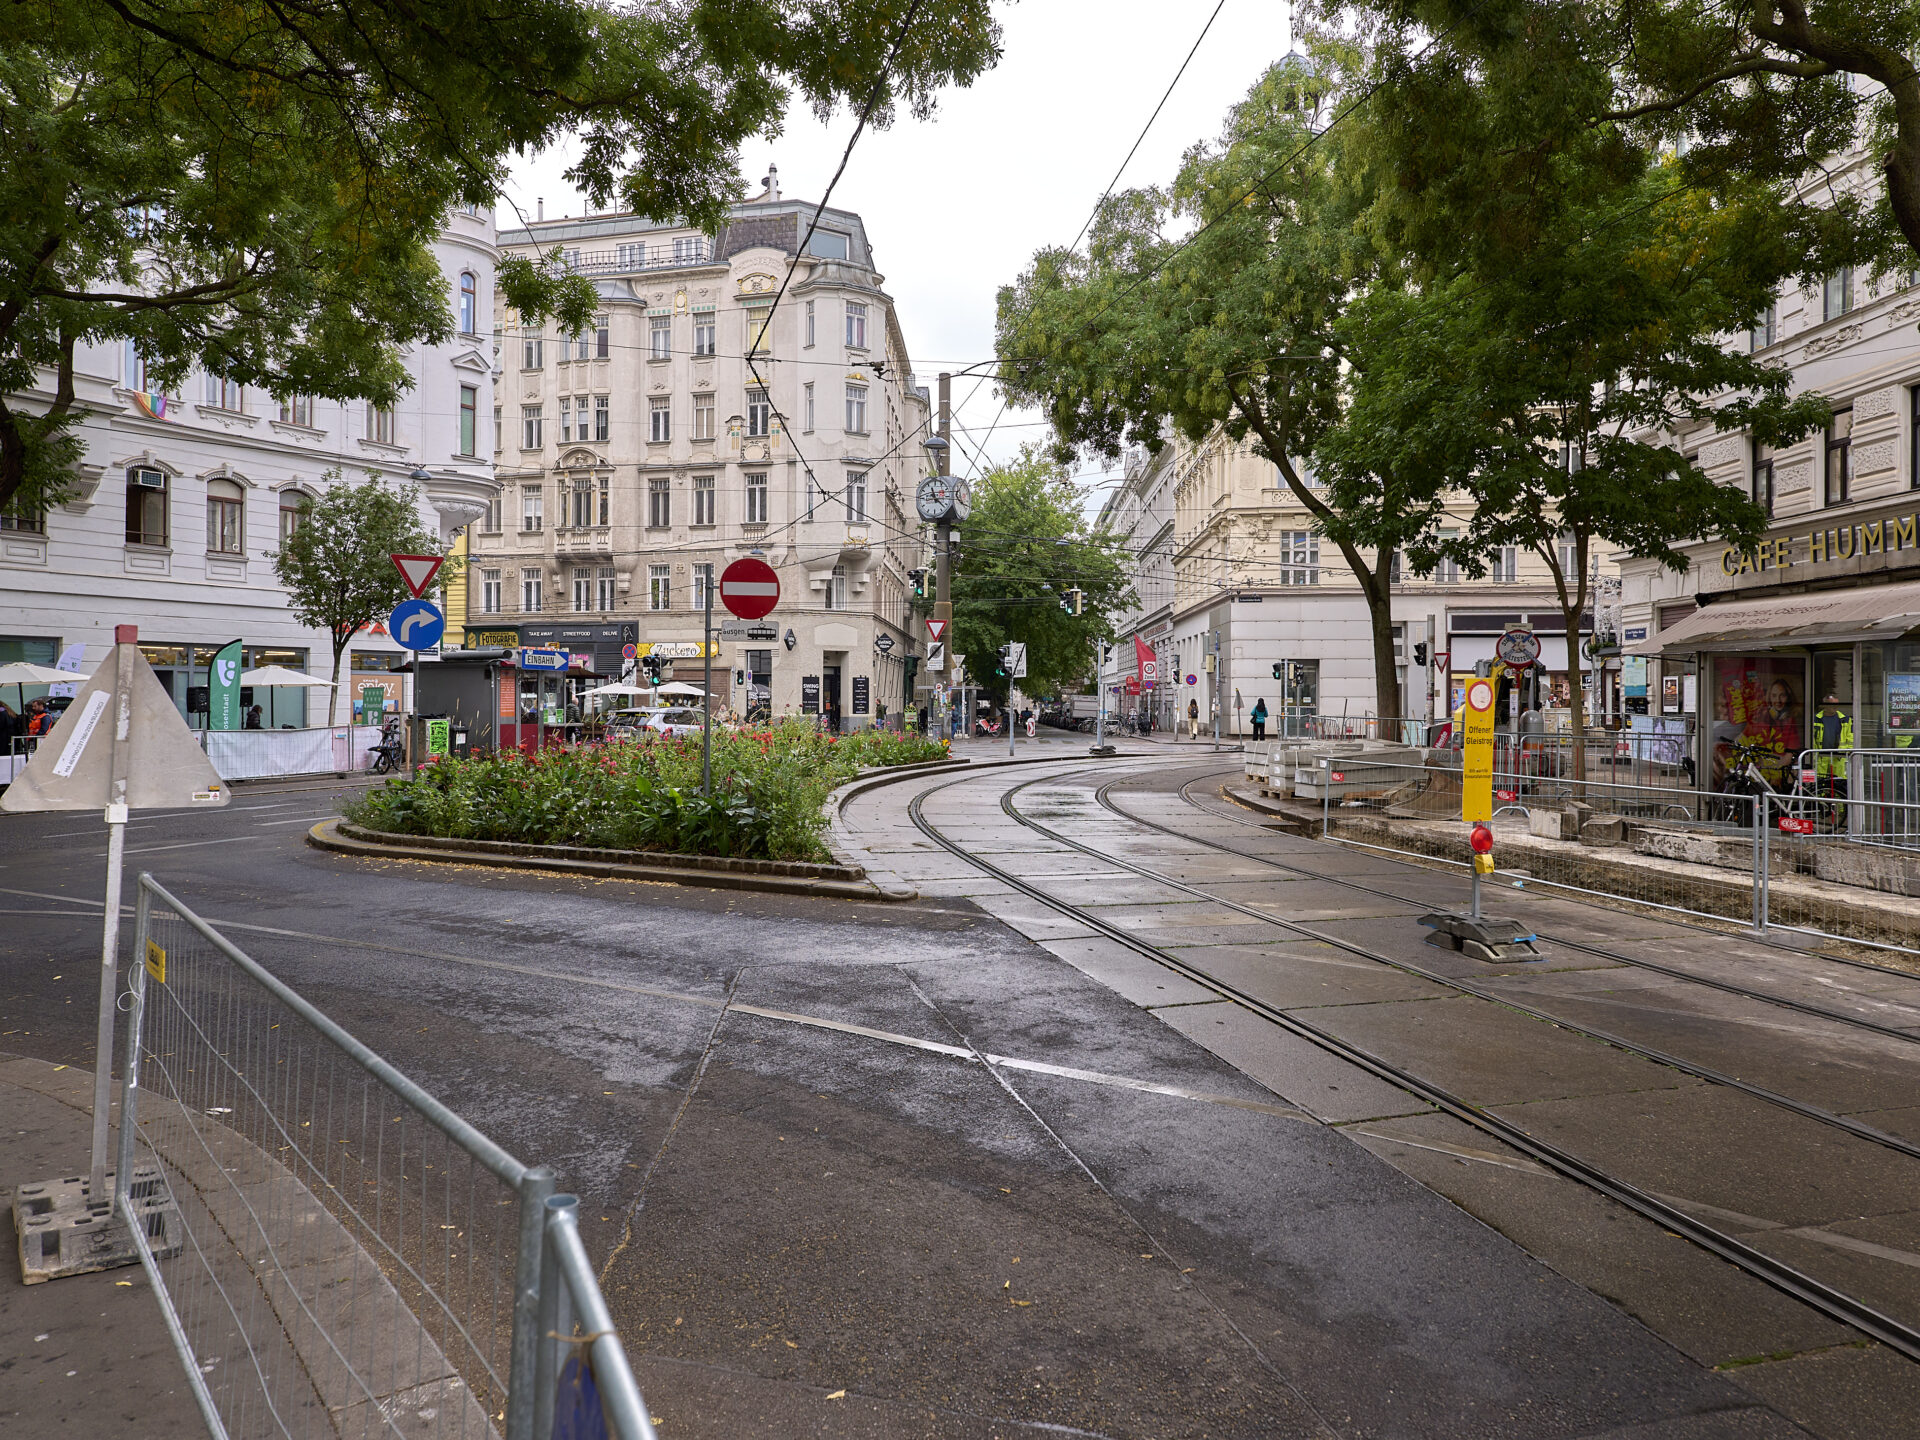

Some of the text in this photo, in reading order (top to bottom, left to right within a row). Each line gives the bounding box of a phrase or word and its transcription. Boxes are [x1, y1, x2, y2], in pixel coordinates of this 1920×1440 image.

[1720, 513, 1920, 577] CAFE HUMM
[482, 633, 517, 646] FOTOGRAFIE
[656, 644, 697, 657] Zuckero
[527, 656, 555, 665] EINBAHN
[1892, 694, 1918, 702] schafft
[1468, 726, 1492, 734] Offener
[1466, 737, 1493, 746] Gleistrog
